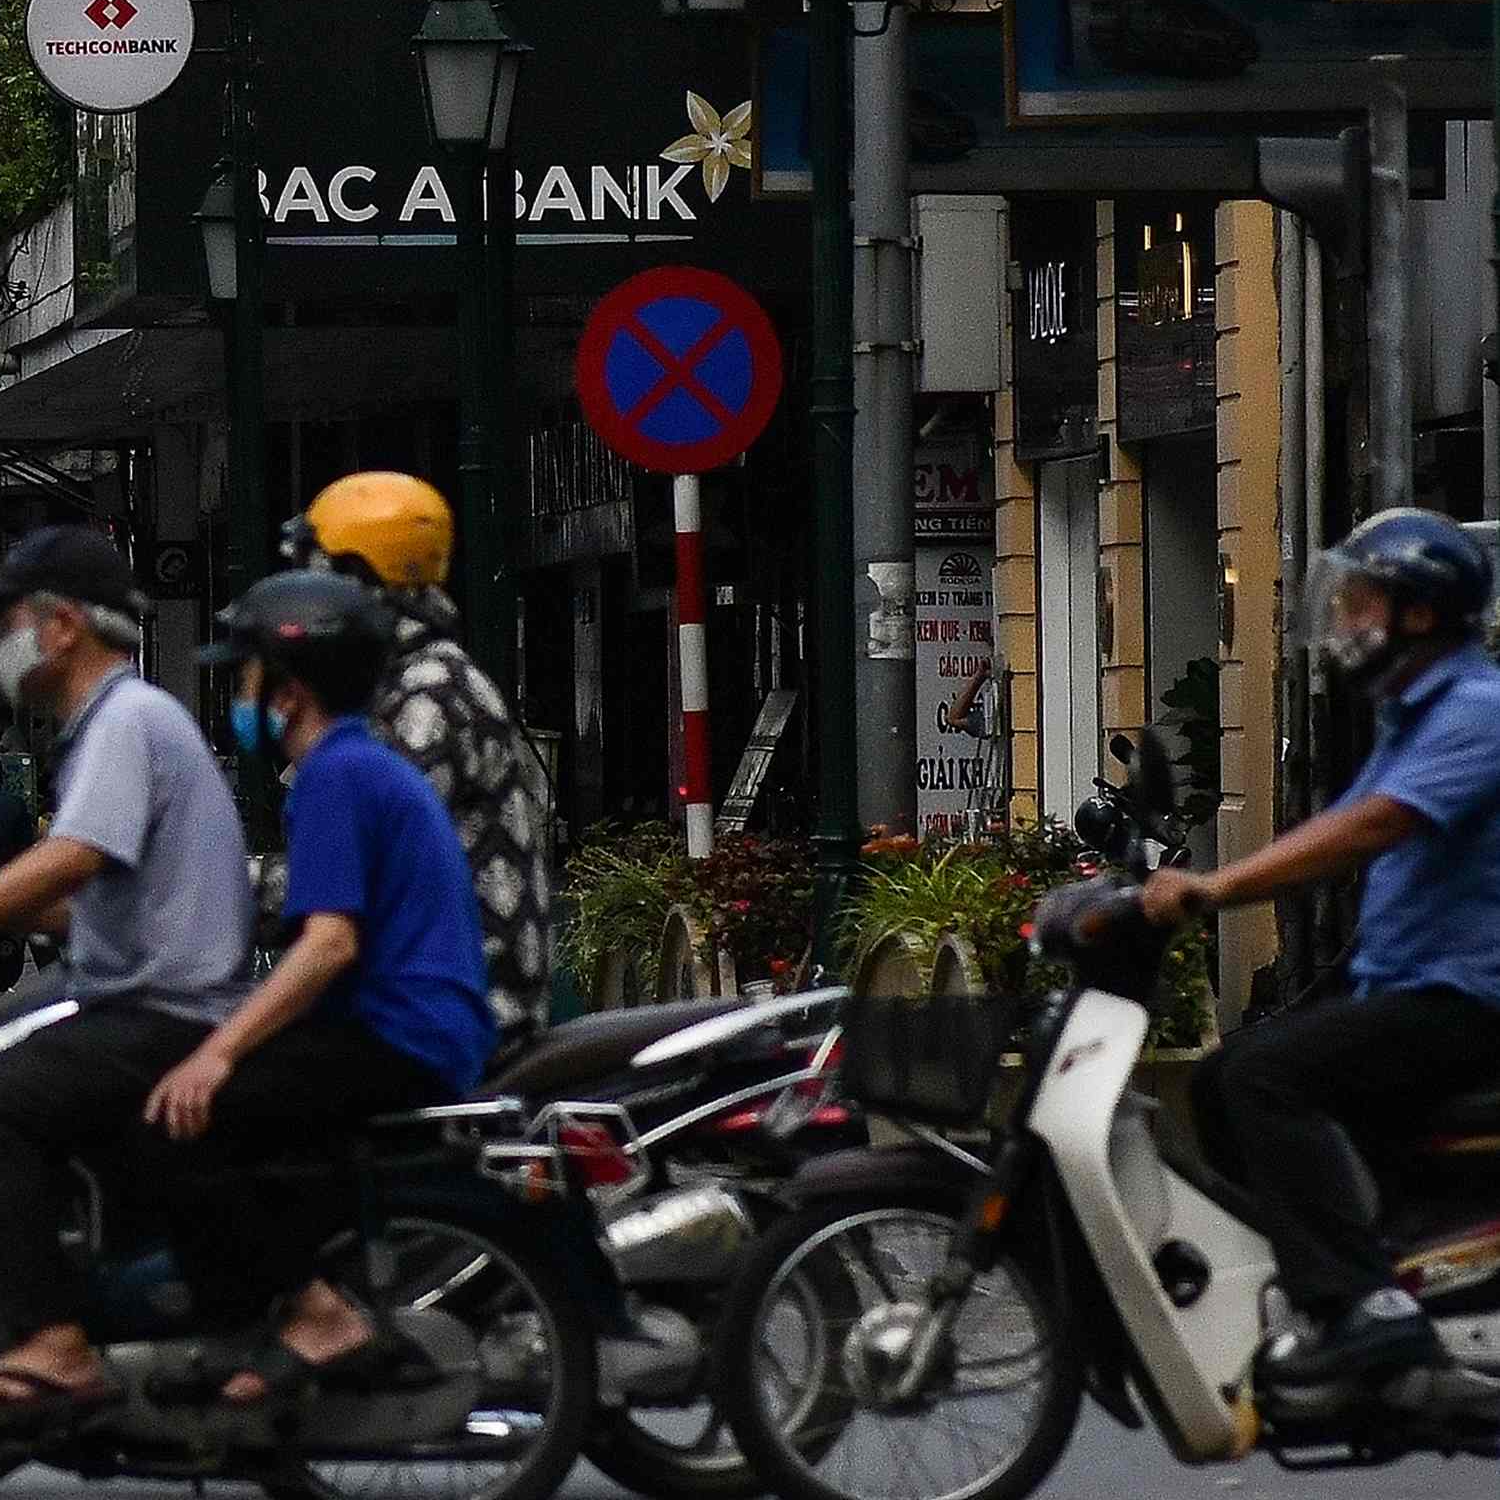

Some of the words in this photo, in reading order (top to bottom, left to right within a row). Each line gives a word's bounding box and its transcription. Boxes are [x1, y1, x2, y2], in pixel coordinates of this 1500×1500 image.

[45, 38, 178, 56] TECHCOMBANK
[258, 166, 379, 222] BAC
[399, 166, 456, 222] A
[483, 164, 697, 222] BANK
[914, 464, 981, 502] EM
[914, 518, 942, 531] NG
